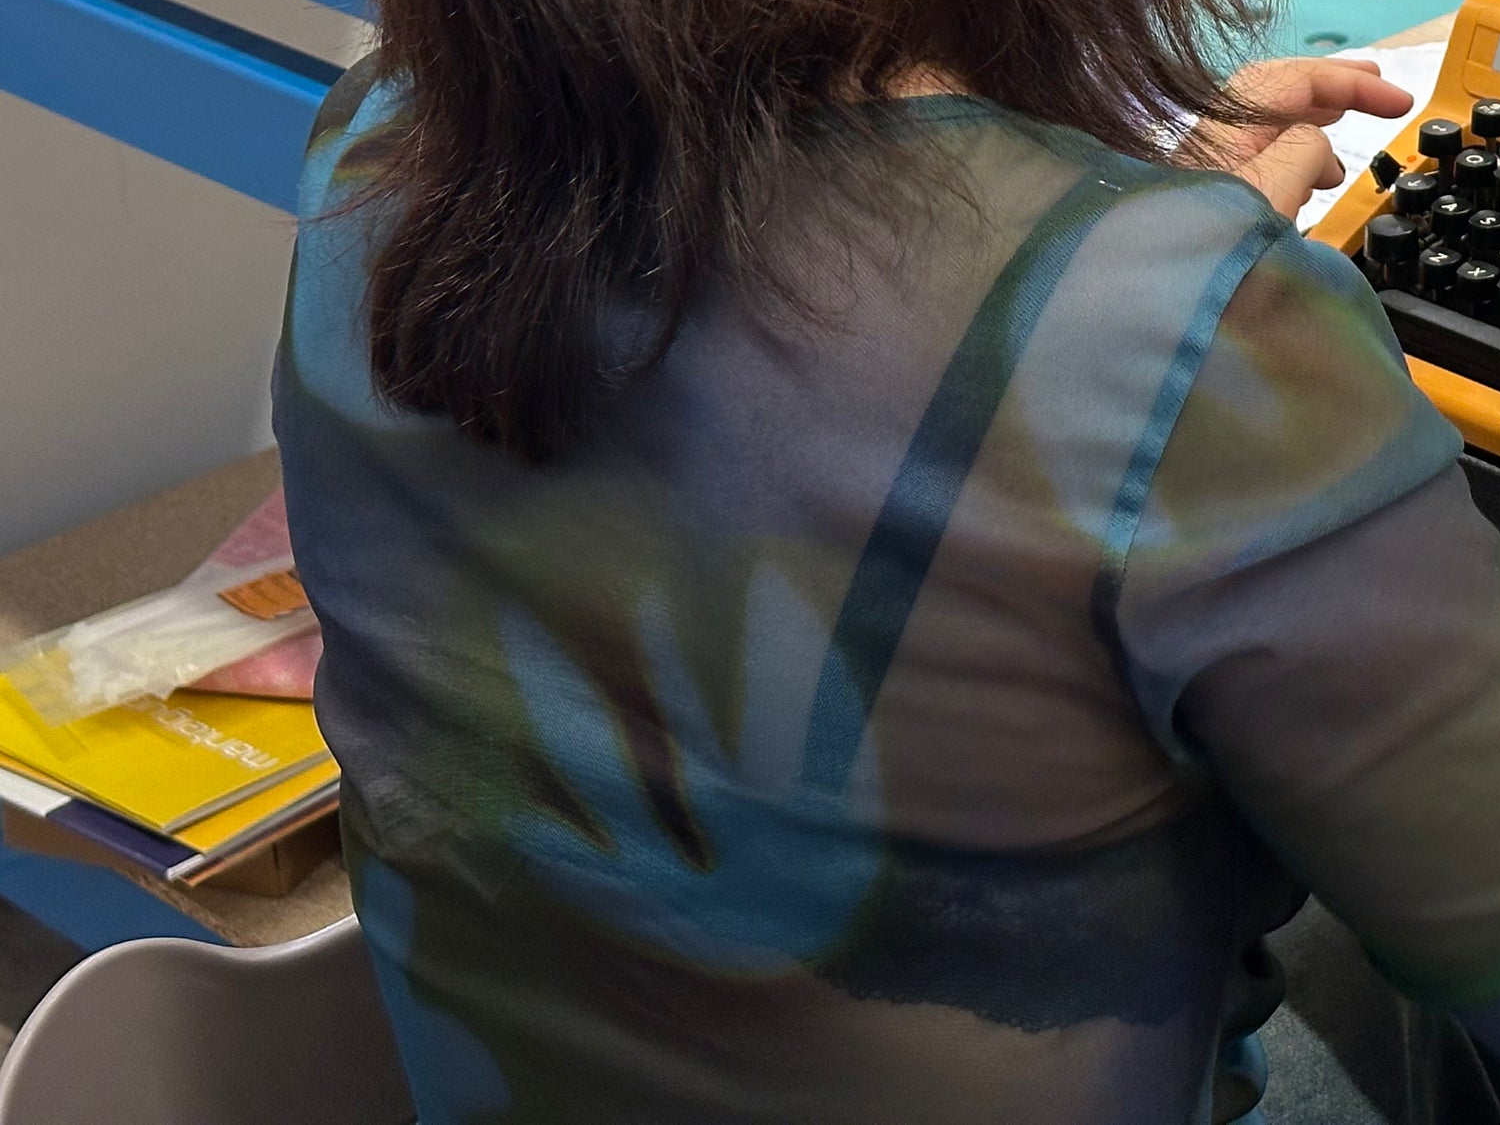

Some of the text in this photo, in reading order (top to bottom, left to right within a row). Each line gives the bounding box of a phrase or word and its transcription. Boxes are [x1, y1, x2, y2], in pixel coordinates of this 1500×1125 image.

[1441, 202, 1458, 212] A
[1480, 217, 1496, 225] S
[1467, 267, 1486, 276] X
